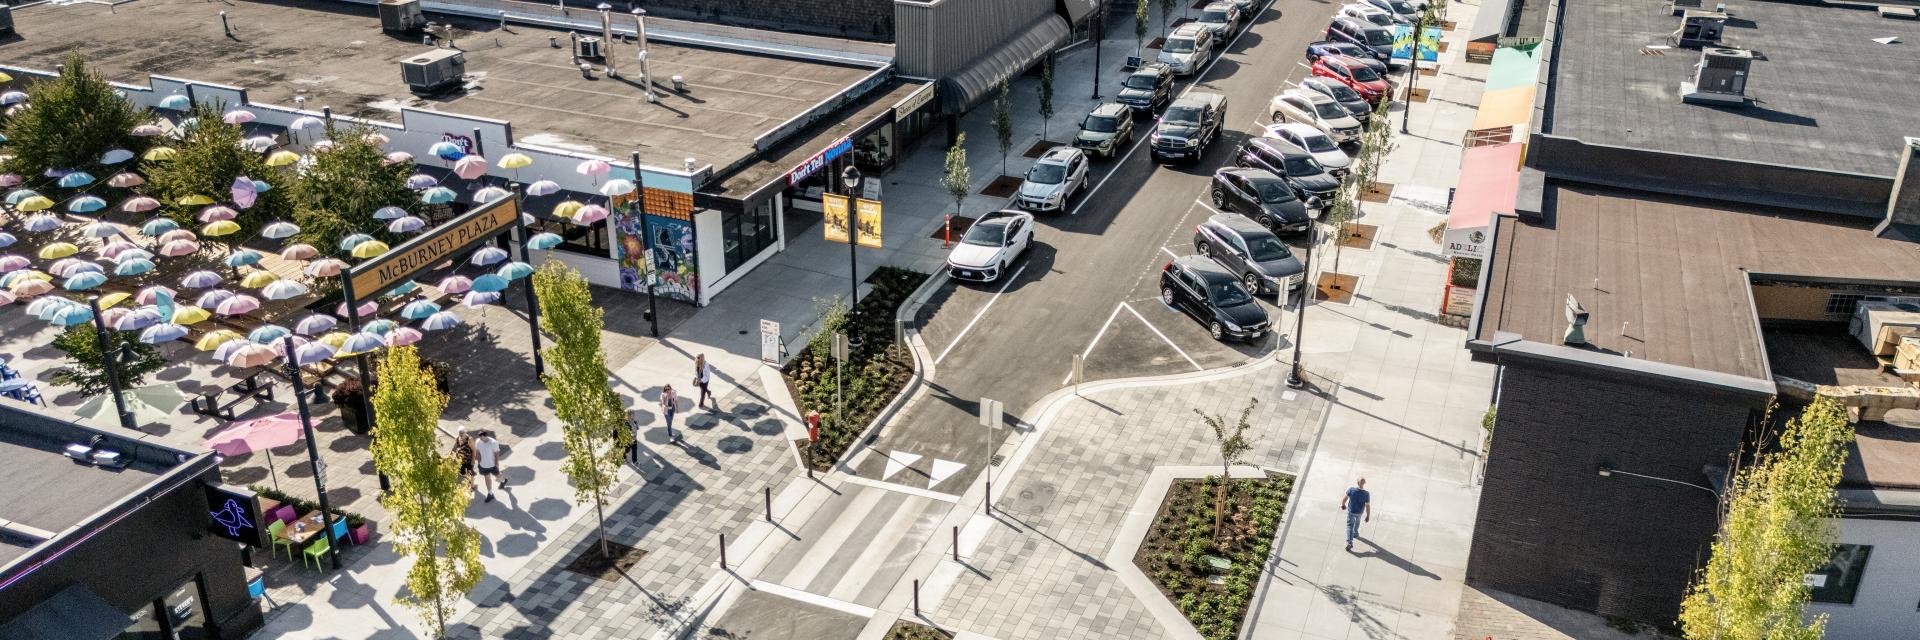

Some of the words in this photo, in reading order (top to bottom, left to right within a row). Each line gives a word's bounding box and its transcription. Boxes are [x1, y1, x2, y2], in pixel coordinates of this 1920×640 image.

[791, 163, 811, 184] Don't
[811, 153, 824, 171] Tell
[825, 136, 853, 161] Nonna
[378, 234, 454, 284] McBURNEY
[458, 213, 498, 243] PLAZA
